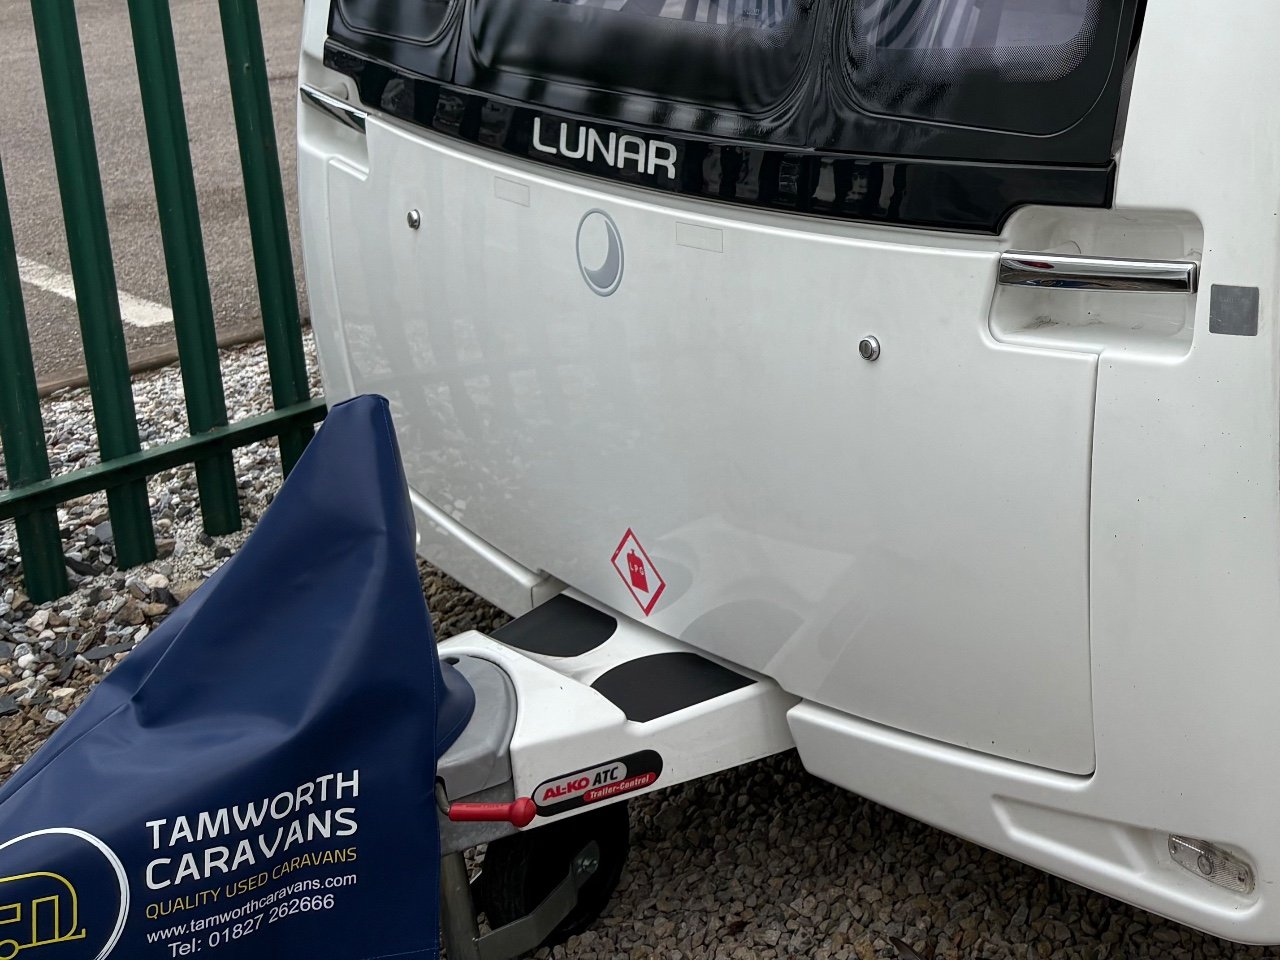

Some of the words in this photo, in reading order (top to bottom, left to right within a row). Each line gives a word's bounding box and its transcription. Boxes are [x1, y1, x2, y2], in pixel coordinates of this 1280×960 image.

[532, 116, 677, 180] LUNAR
[145, 769, 359, 850] TAMWORTH
[542, 776, 591, 801] AL-KO
[592, 766, 619, 786] ATC
[589, 774, 649, 799] Trailer-Control
[145, 807, 358, 890] CARAVANS
[146, 887, 221, 920] QUALITY
[225, 872, 268, 898] USED
[272, 847, 357, 880] CARAVANS
[146, 874, 357, 944] www.tamworthcaravans.com
[168, 938, 202, 958] Tel:
[208, 915, 264, 948] 01827
[268, 894, 335, 923] 262666
